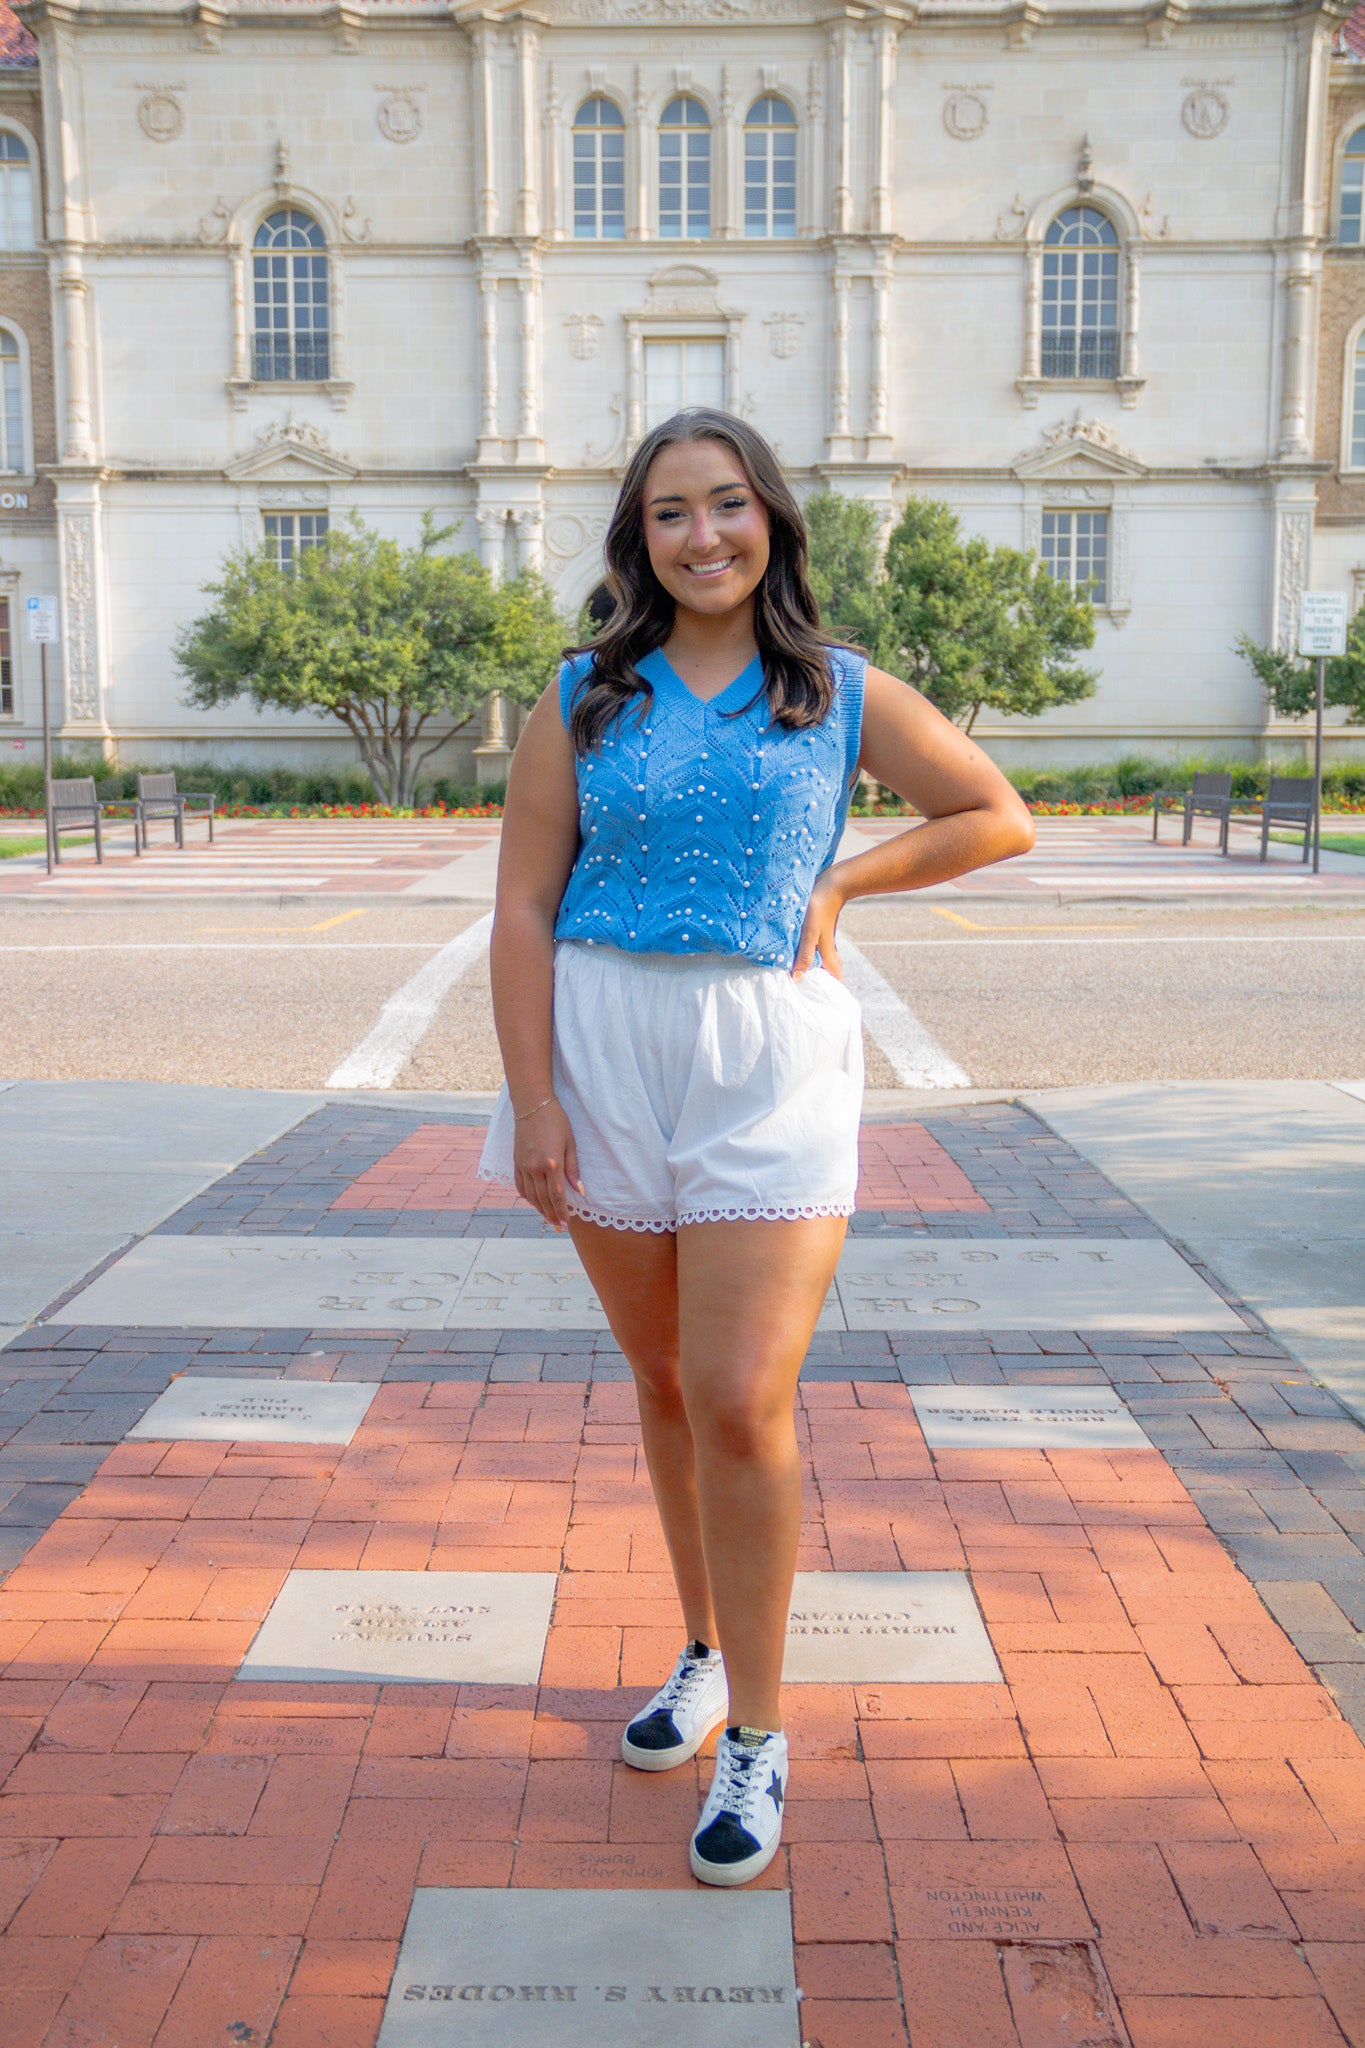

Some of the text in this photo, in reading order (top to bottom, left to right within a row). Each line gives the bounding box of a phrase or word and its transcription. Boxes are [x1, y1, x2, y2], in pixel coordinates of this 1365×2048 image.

[293, 1737, 334, 1746] GREG
[577, 1854, 636, 1865] BURNS
[549, 1867, 664, 1879] JOHN AND LIZ
[926, 1890, 1045, 1902] WHITTINGTON
[948, 1905, 1033, 1917] KENNETH
[948, 1921, 1040, 1933] ALICE AND
[403, 1984, 785, 2004] REUBY S. RHODES
